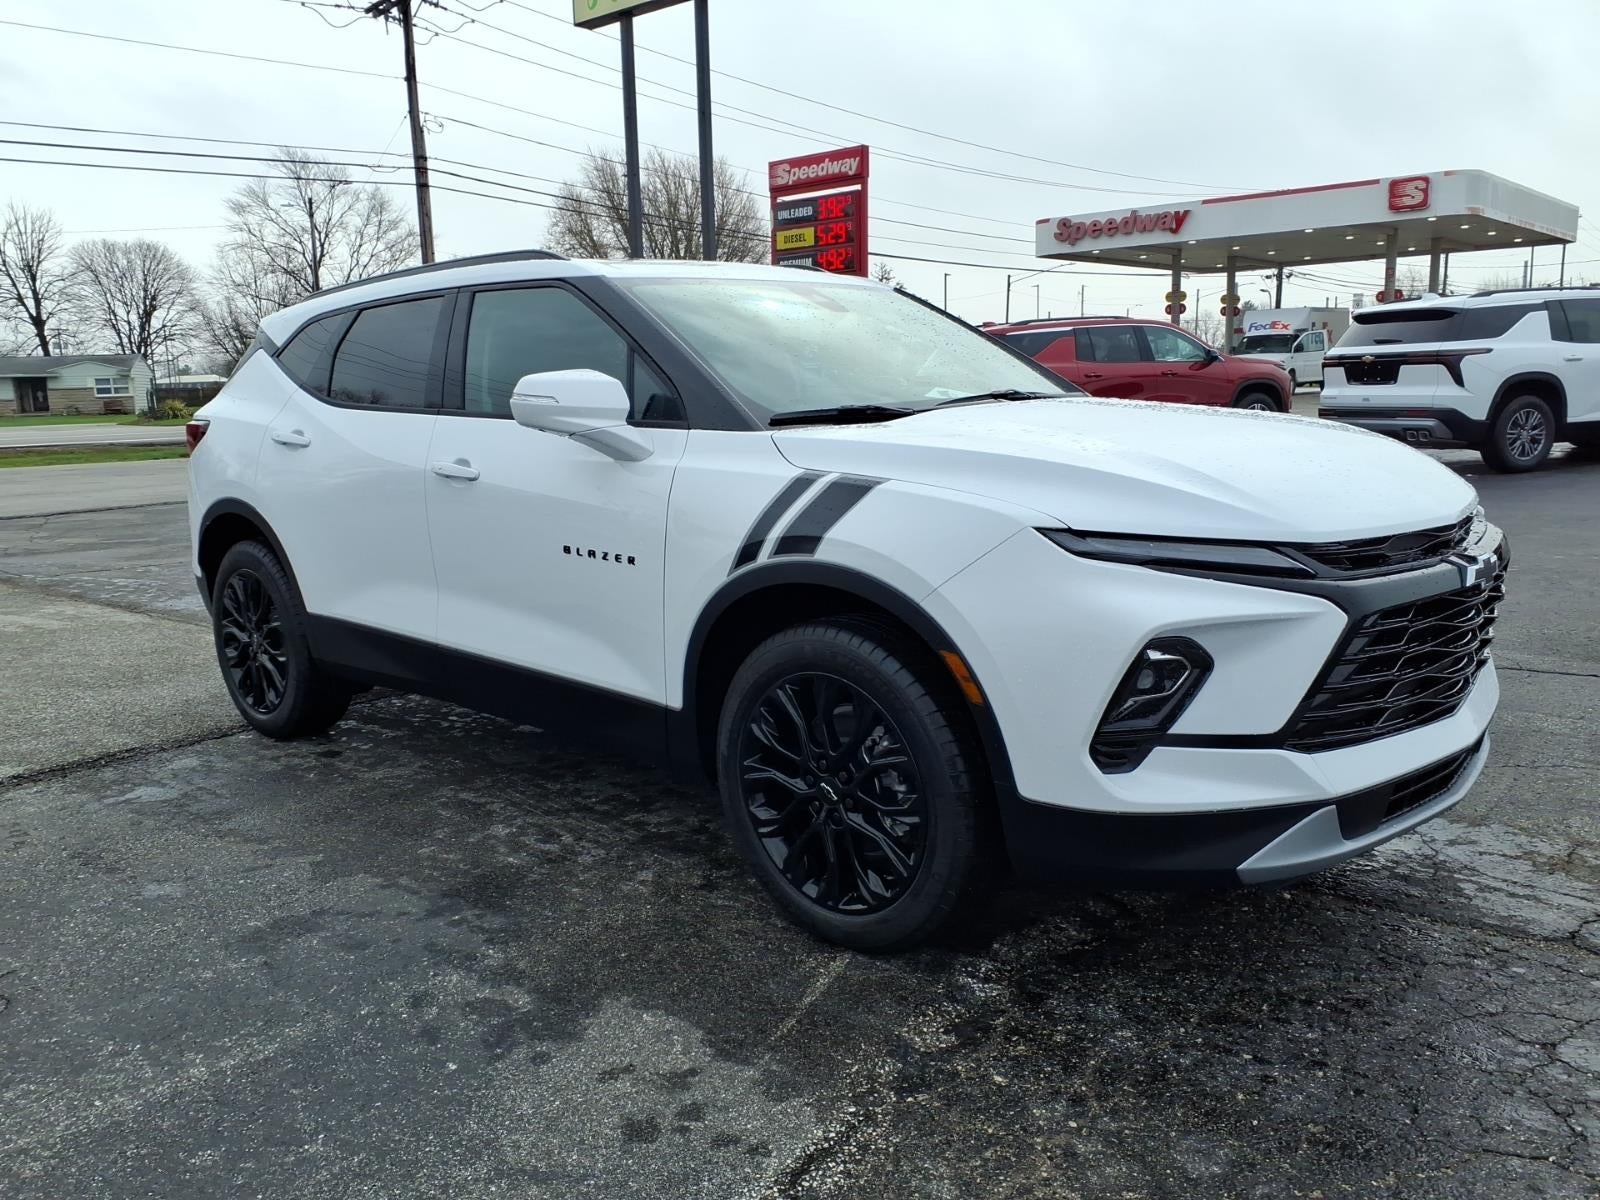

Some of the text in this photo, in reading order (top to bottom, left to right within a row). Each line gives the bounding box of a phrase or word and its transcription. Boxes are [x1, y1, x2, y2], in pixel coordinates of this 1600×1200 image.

[772, 157, 860, 185] Speedway
[777, 206, 813, 220] UNLEADED
[1054, 209, 1192, 246] Speedway
[783, 233, 807, 244] DIESEL
[1248, 320, 1291, 332] FedEx
[563, 545, 636, 566] BLAZER
